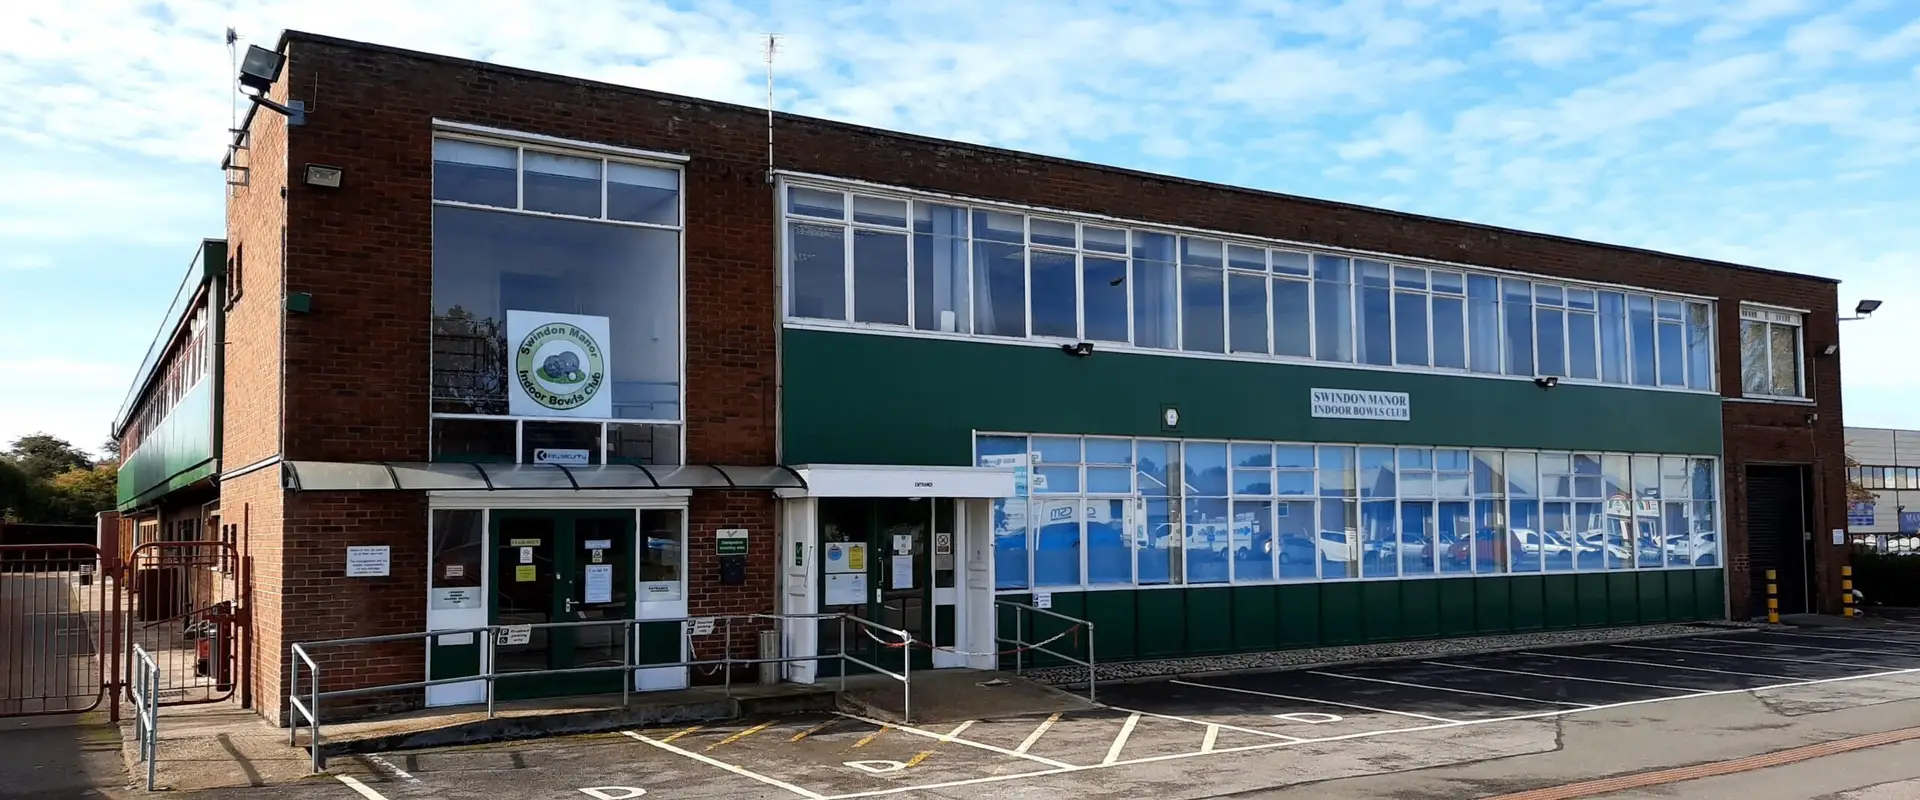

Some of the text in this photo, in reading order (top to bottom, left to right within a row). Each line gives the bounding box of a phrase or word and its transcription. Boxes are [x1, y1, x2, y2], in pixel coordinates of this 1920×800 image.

[521, 326, 598, 358] Swindon Manor
[519, 369, 601, 406] Indoor Bowls Club
[1313, 391, 1407, 406] SWINDON MANOR
[1314, 404, 1408, 418] INDOOR BOWLS CLUB
